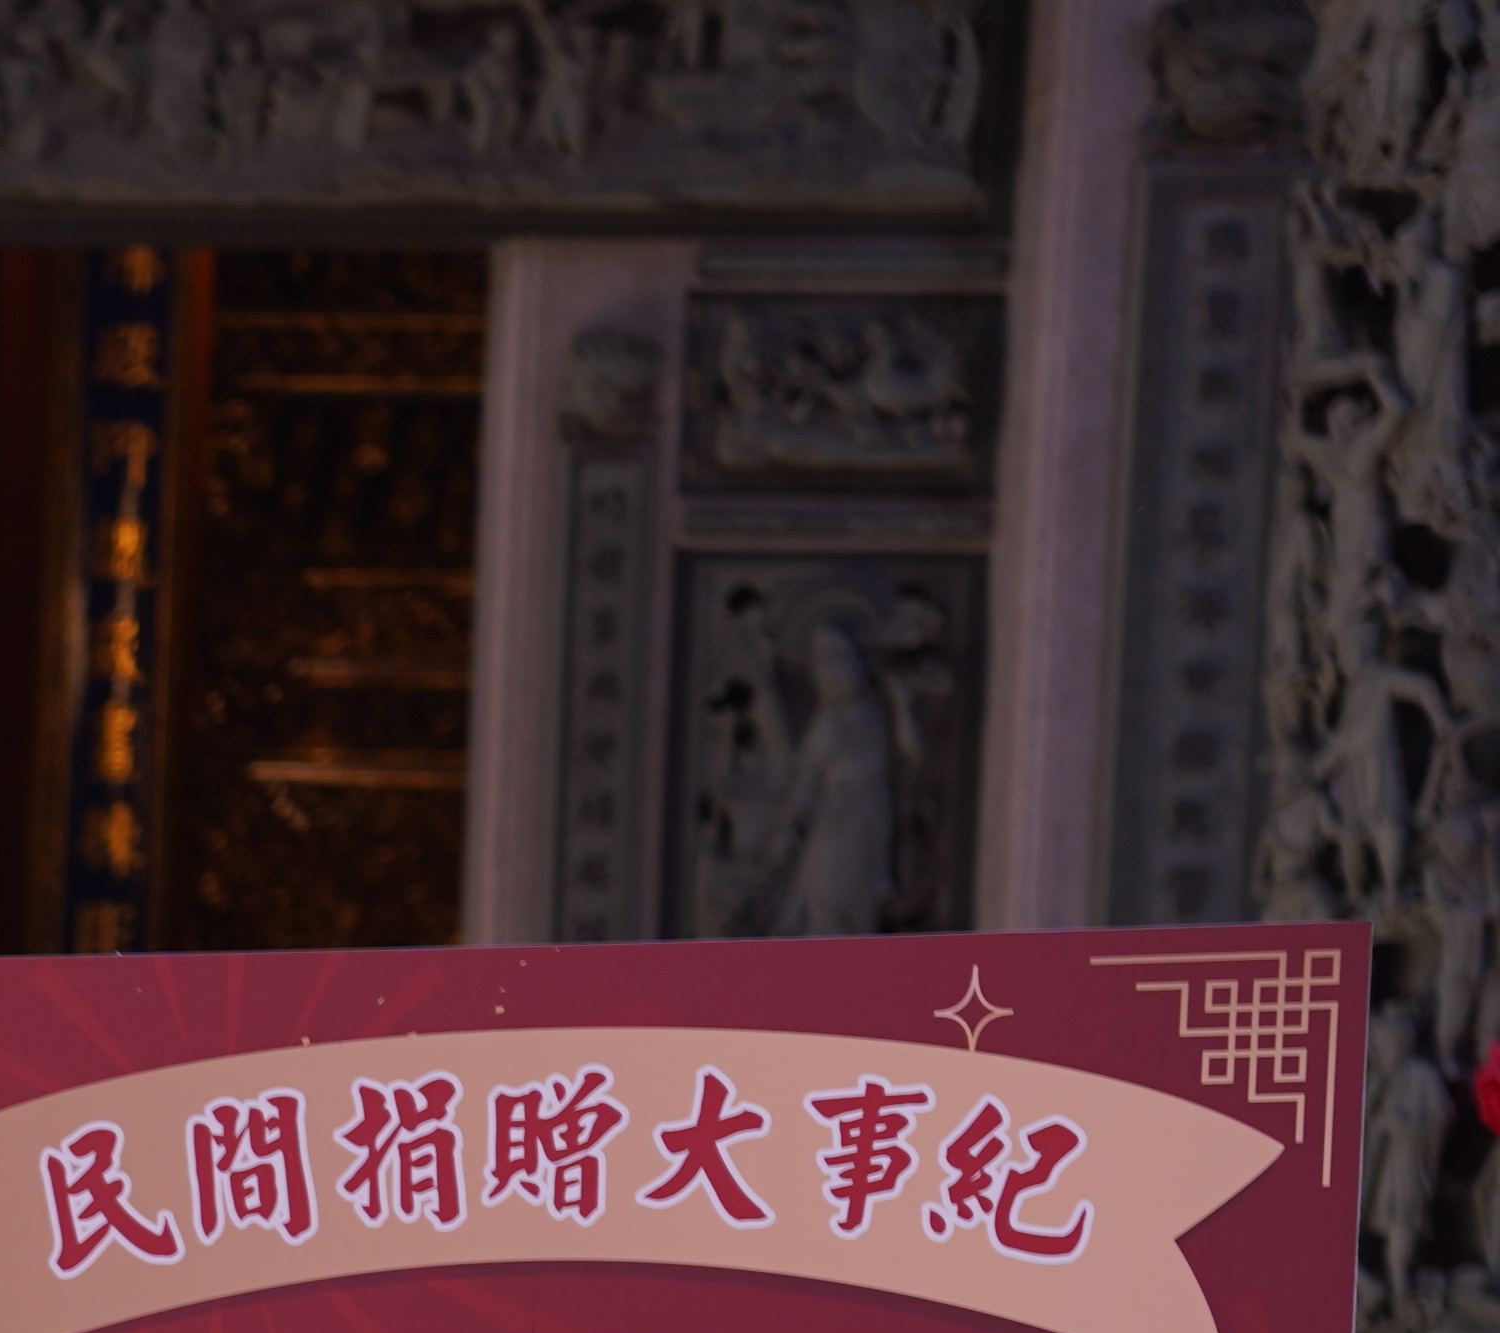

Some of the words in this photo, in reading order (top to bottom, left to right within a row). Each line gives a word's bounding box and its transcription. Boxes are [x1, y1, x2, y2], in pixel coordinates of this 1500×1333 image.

[37, 1062, 1094, 1282] 民間捐贈大事紀
